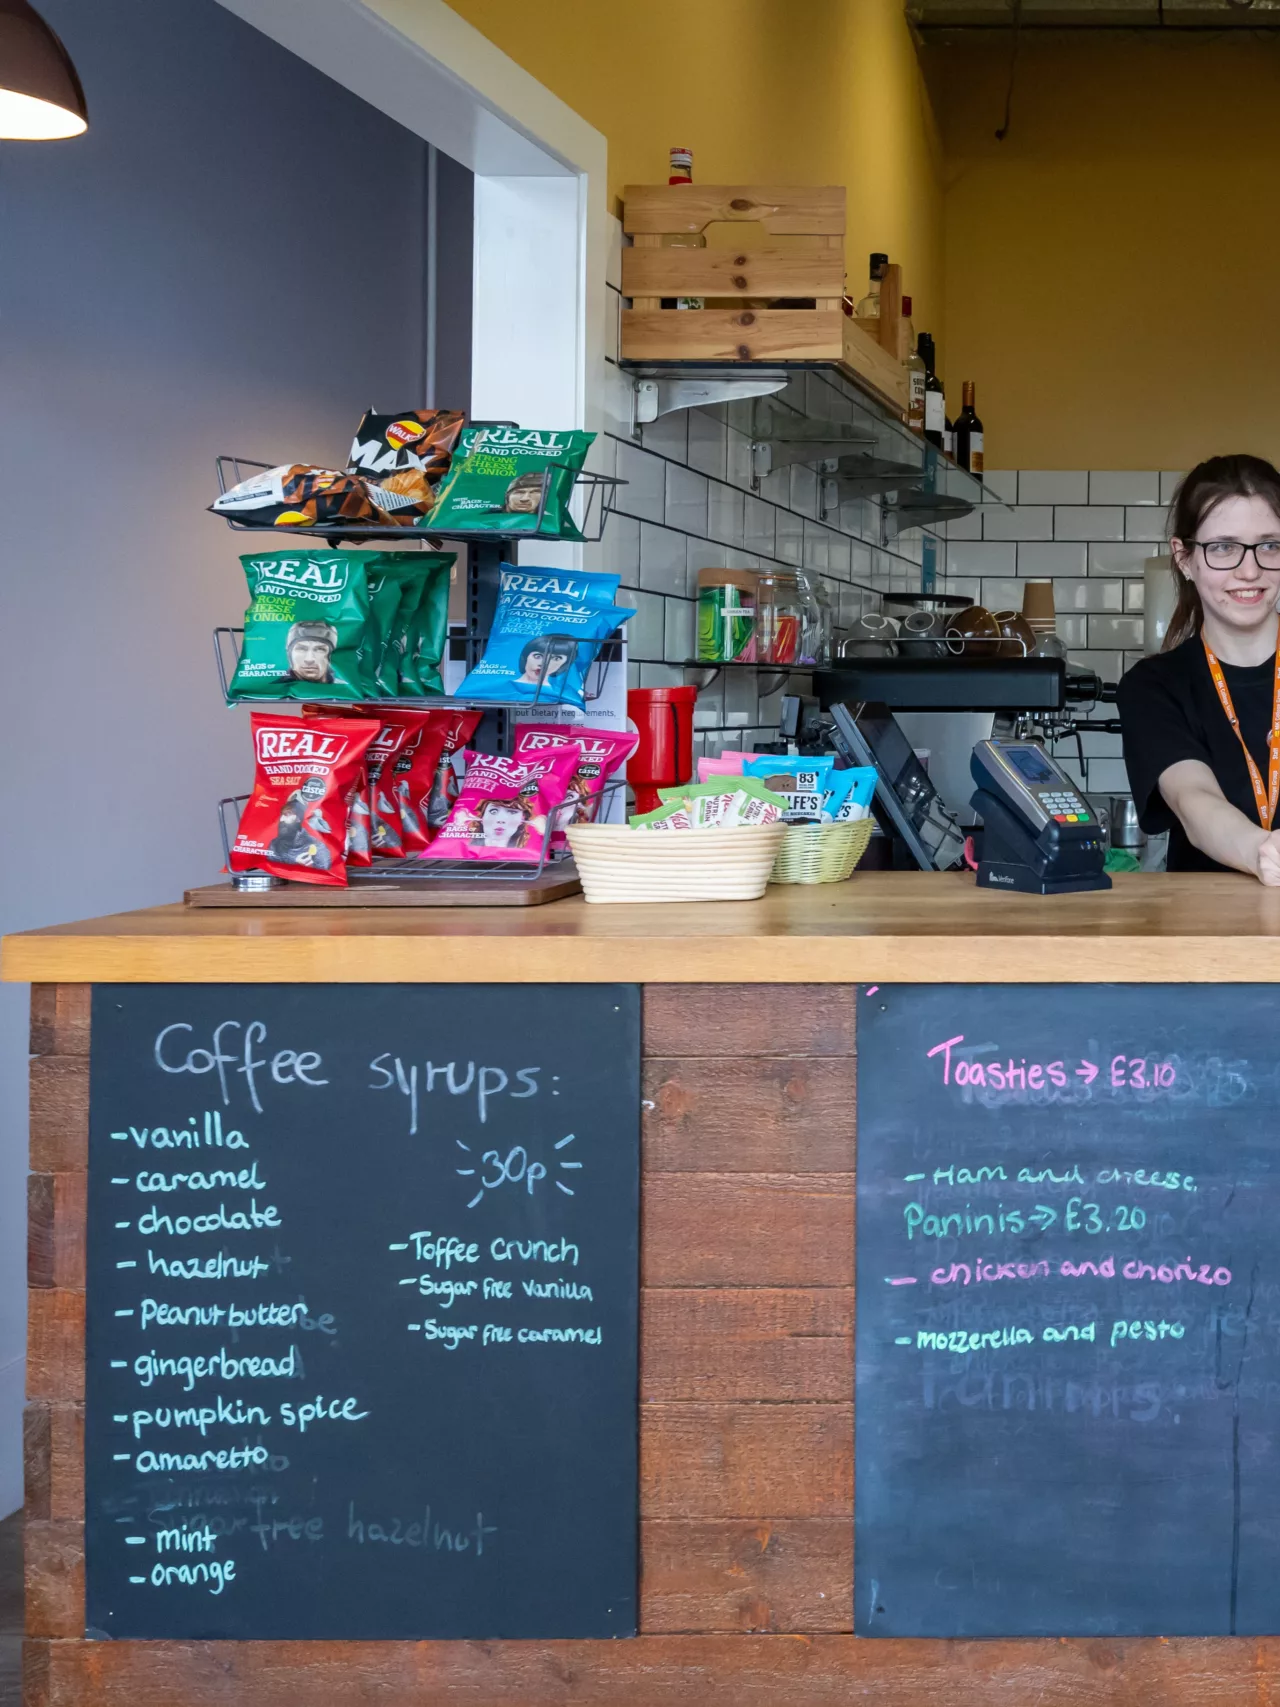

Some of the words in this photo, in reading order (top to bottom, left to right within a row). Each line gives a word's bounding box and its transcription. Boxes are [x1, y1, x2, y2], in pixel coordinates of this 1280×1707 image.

[511, 447, 562, 457] COOKED
[477, 468, 517, 476] ONION
[259, 559, 344, 588] REAL
[503, 574, 580, 598] REAL
[288, 589, 342, 603] COOKED
[513, 594, 592, 615] REAL
[253, 612, 296, 622] ONION
[540, 613, 588, 624] COOKED
[531, 709, 559, 718] Dietary
[261, 732, 335, 758] REAL
[264, 765, 293, 775] HAND
[578, 768, 600, 776] taste
[799, 773, 814, 783] 83
[302, 785, 325, 795] taste
[744, 801, 757, 820] GRAIN
[153, 1020, 330, 1114] Coffee
[927, 1035, 1069, 1089] Toasties
[1110, 1054, 1176, 1088] £3.10
[136, 1161, 267, 1192] caramel
[482, 1146, 547, 1195] 30p
[1017, 1165, 1085, 1184] and
[138, 1198, 282, 1235] chocolate
[904, 1202, 1025, 1239] Paninis
[1066, 1197, 1146, 1234] £3.20
[147, 1249, 269, 1279] hazelnut
[409, 1231, 480, 1270] Toffee
[930, 1257, 1049, 1285] chicken
[1060, 1256, 1115, 1279] and
[1122, 1255, 1232, 1286] chorizo
[419, 1273, 478, 1308] Sugar
[424, 1318, 478, 1350] Sugar
[517, 1326, 602, 1345] caramel
[1042, 1321, 1095, 1342] and
[1110, 1319, 1185, 1348] pesto
[133, 1345, 296, 1391] gingerbread
[132, 1402, 271, 1438] pumpkin
[280, 1396, 369, 1433] spice
[136, 1446, 269, 1473] amaretto
[156, 1524, 218, 1553] mint
[151, 1559, 237, 1595] orange
